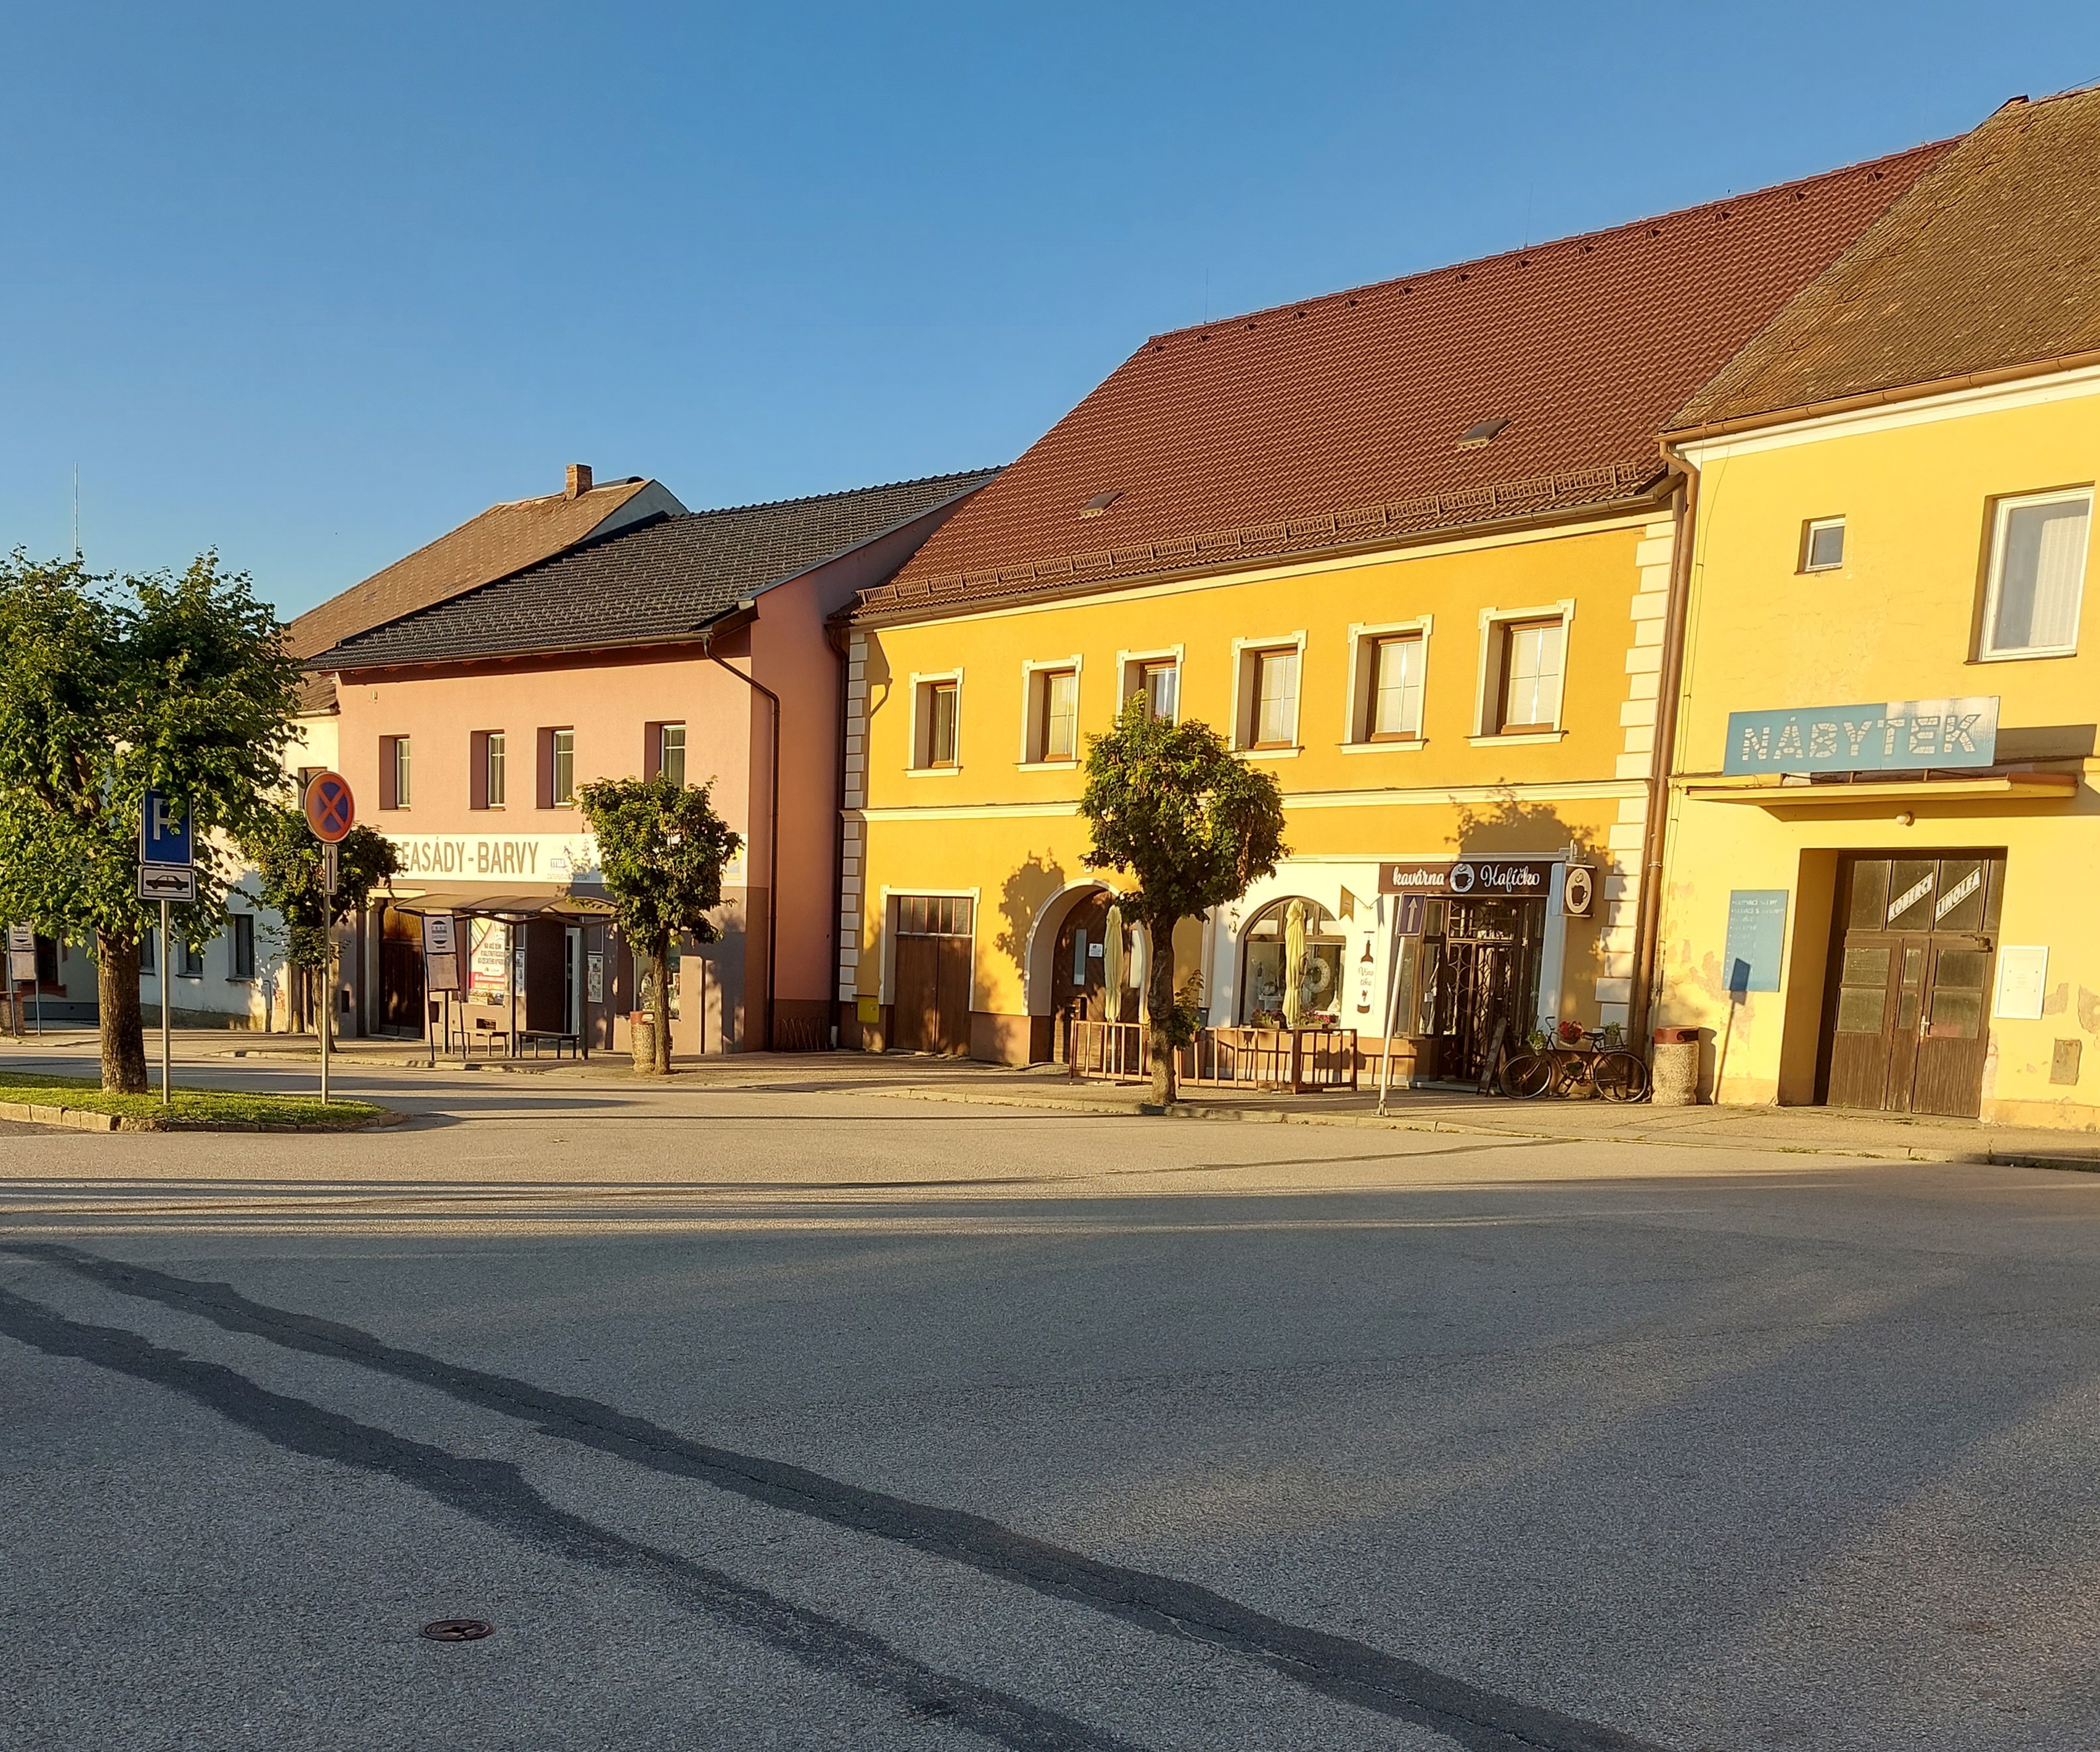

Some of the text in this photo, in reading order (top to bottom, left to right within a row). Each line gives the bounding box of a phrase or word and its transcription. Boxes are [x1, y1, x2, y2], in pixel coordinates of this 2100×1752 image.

[1742, 713, 1981, 761] NÁBYTEK
[401, 836, 465, 873] FASÁDY
[477, 841, 539, 875] BARVY
[1393, 863, 1540, 893] kavárna Kafíčko
[1888, 874, 1933, 921] KOBERCE
[1935, 870, 1981, 920] LINOLEA
